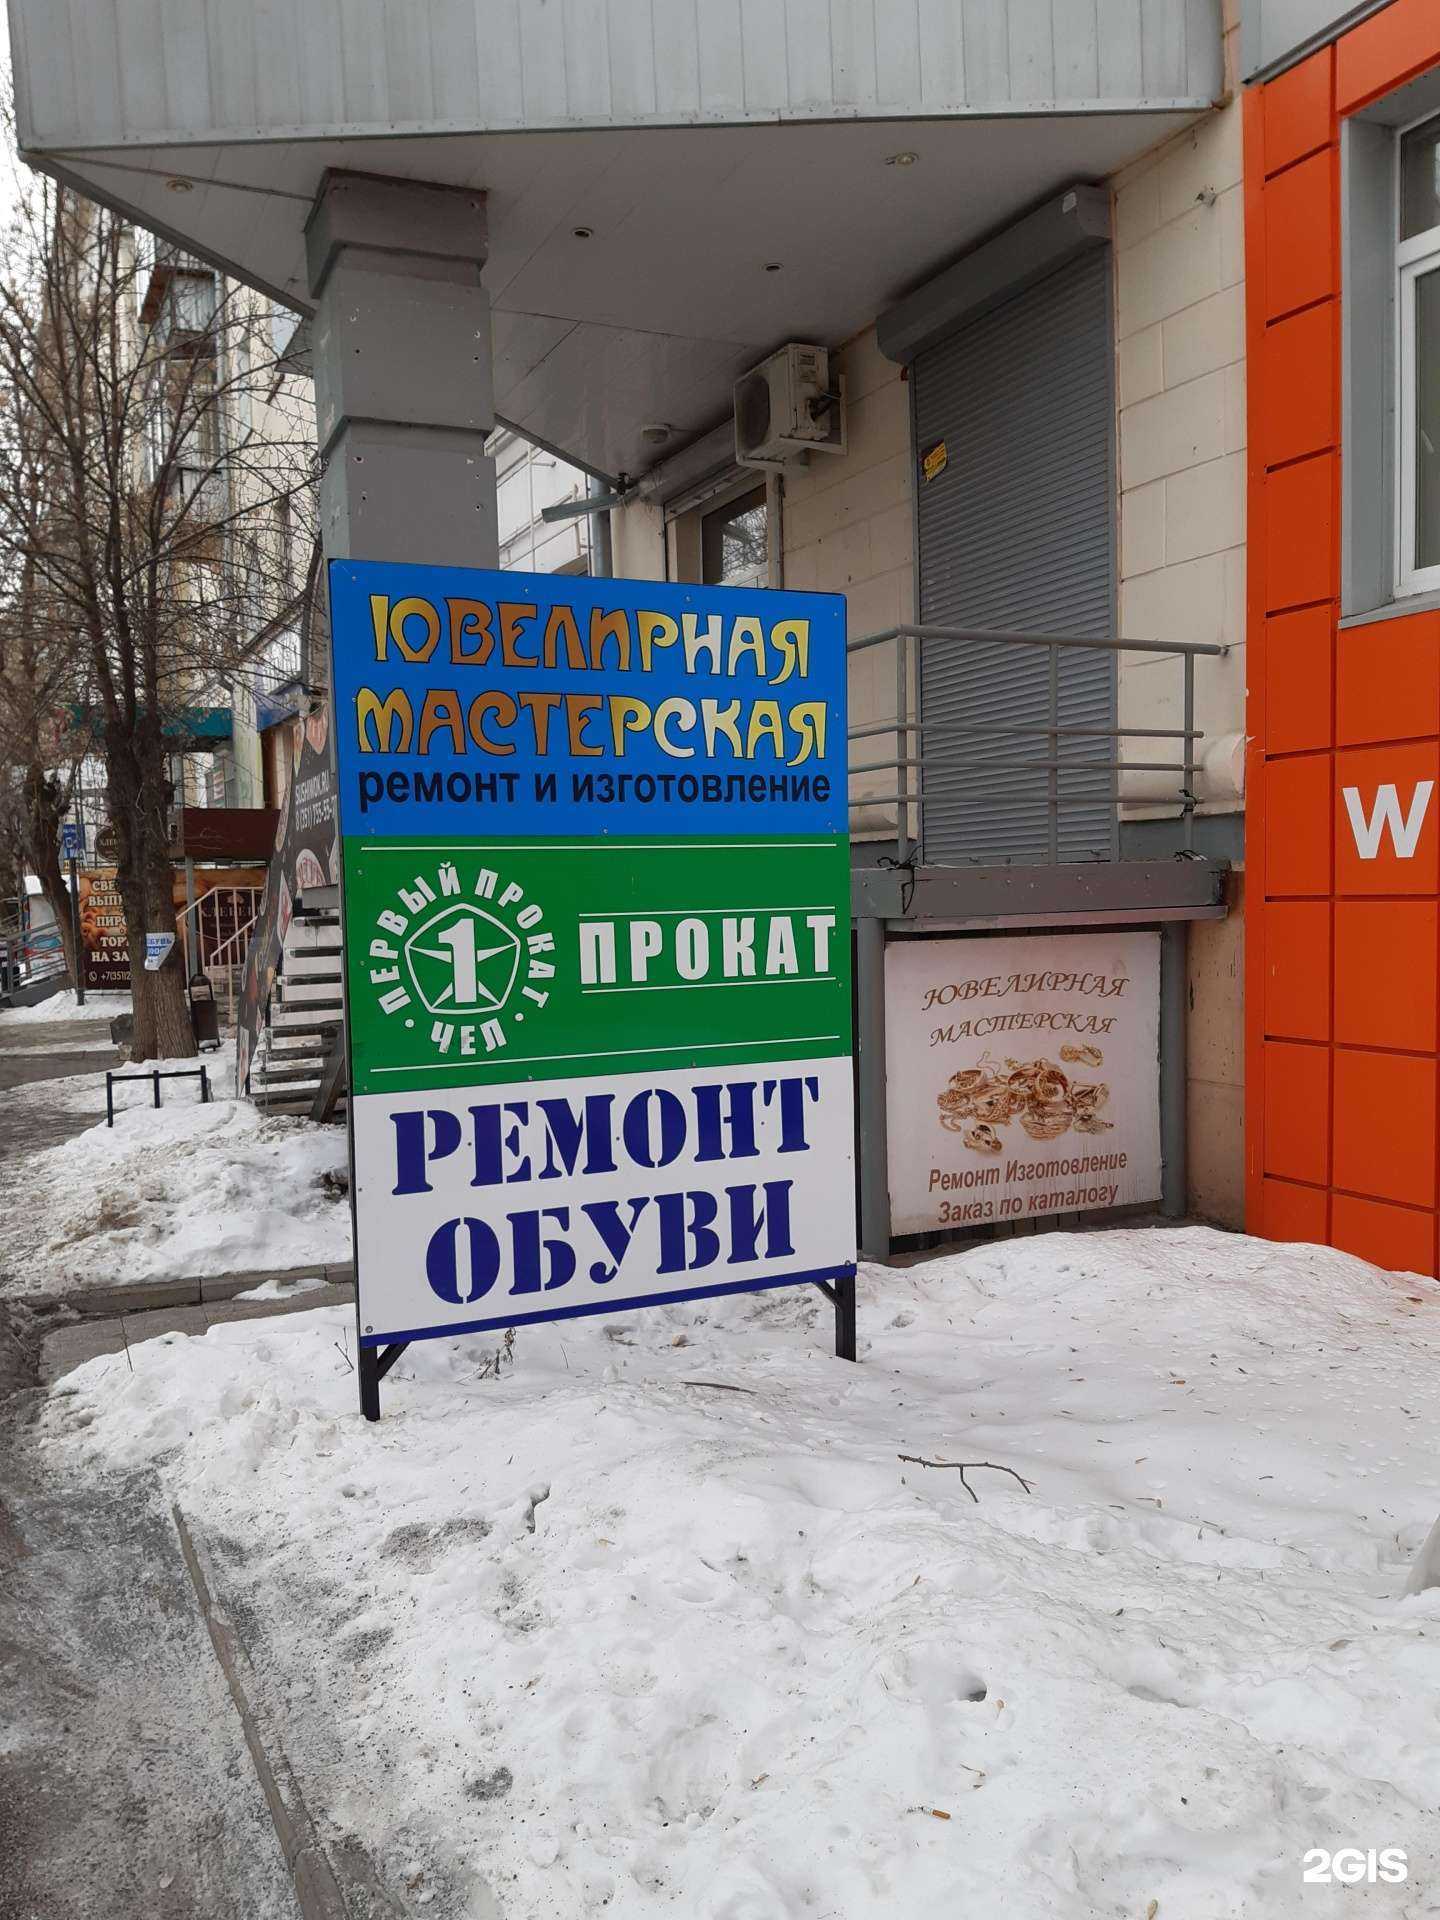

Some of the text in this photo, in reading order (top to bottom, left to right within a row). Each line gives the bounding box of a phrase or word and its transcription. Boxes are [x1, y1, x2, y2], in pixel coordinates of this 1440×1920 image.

[369, 593, 811, 686] ЮВЕЛИРНАЯ
[356, 686, 828, 768] МАСТЕРСКАЯ
[358, 771, 832, 813] ремонт и изготовление
[1342, 780, 1435, 859] W
[369, 861, 556, 1015] ПЕРВЫЙ ПРОКАТ
[438, 918, 477, 1004] 1
[579, 914, 836, 985] ПРОКАТ
[922, 971, 1130, 1010] ЮВЕЛИРНАЯ
[430, 1018, 507, 1056] ЧЕЛ
[930, 1012, 1117, 1047] МАСТЕРСКАЯ
[389, 1076, 820, 1196] РЕМОНТ
[928, 1152, 1128, 1192] Ремонт Изготовление
[937, 1184, 1119, 1224] Заказ по каталогу
[425, 1179, 796, 1305] ОБУВИ
